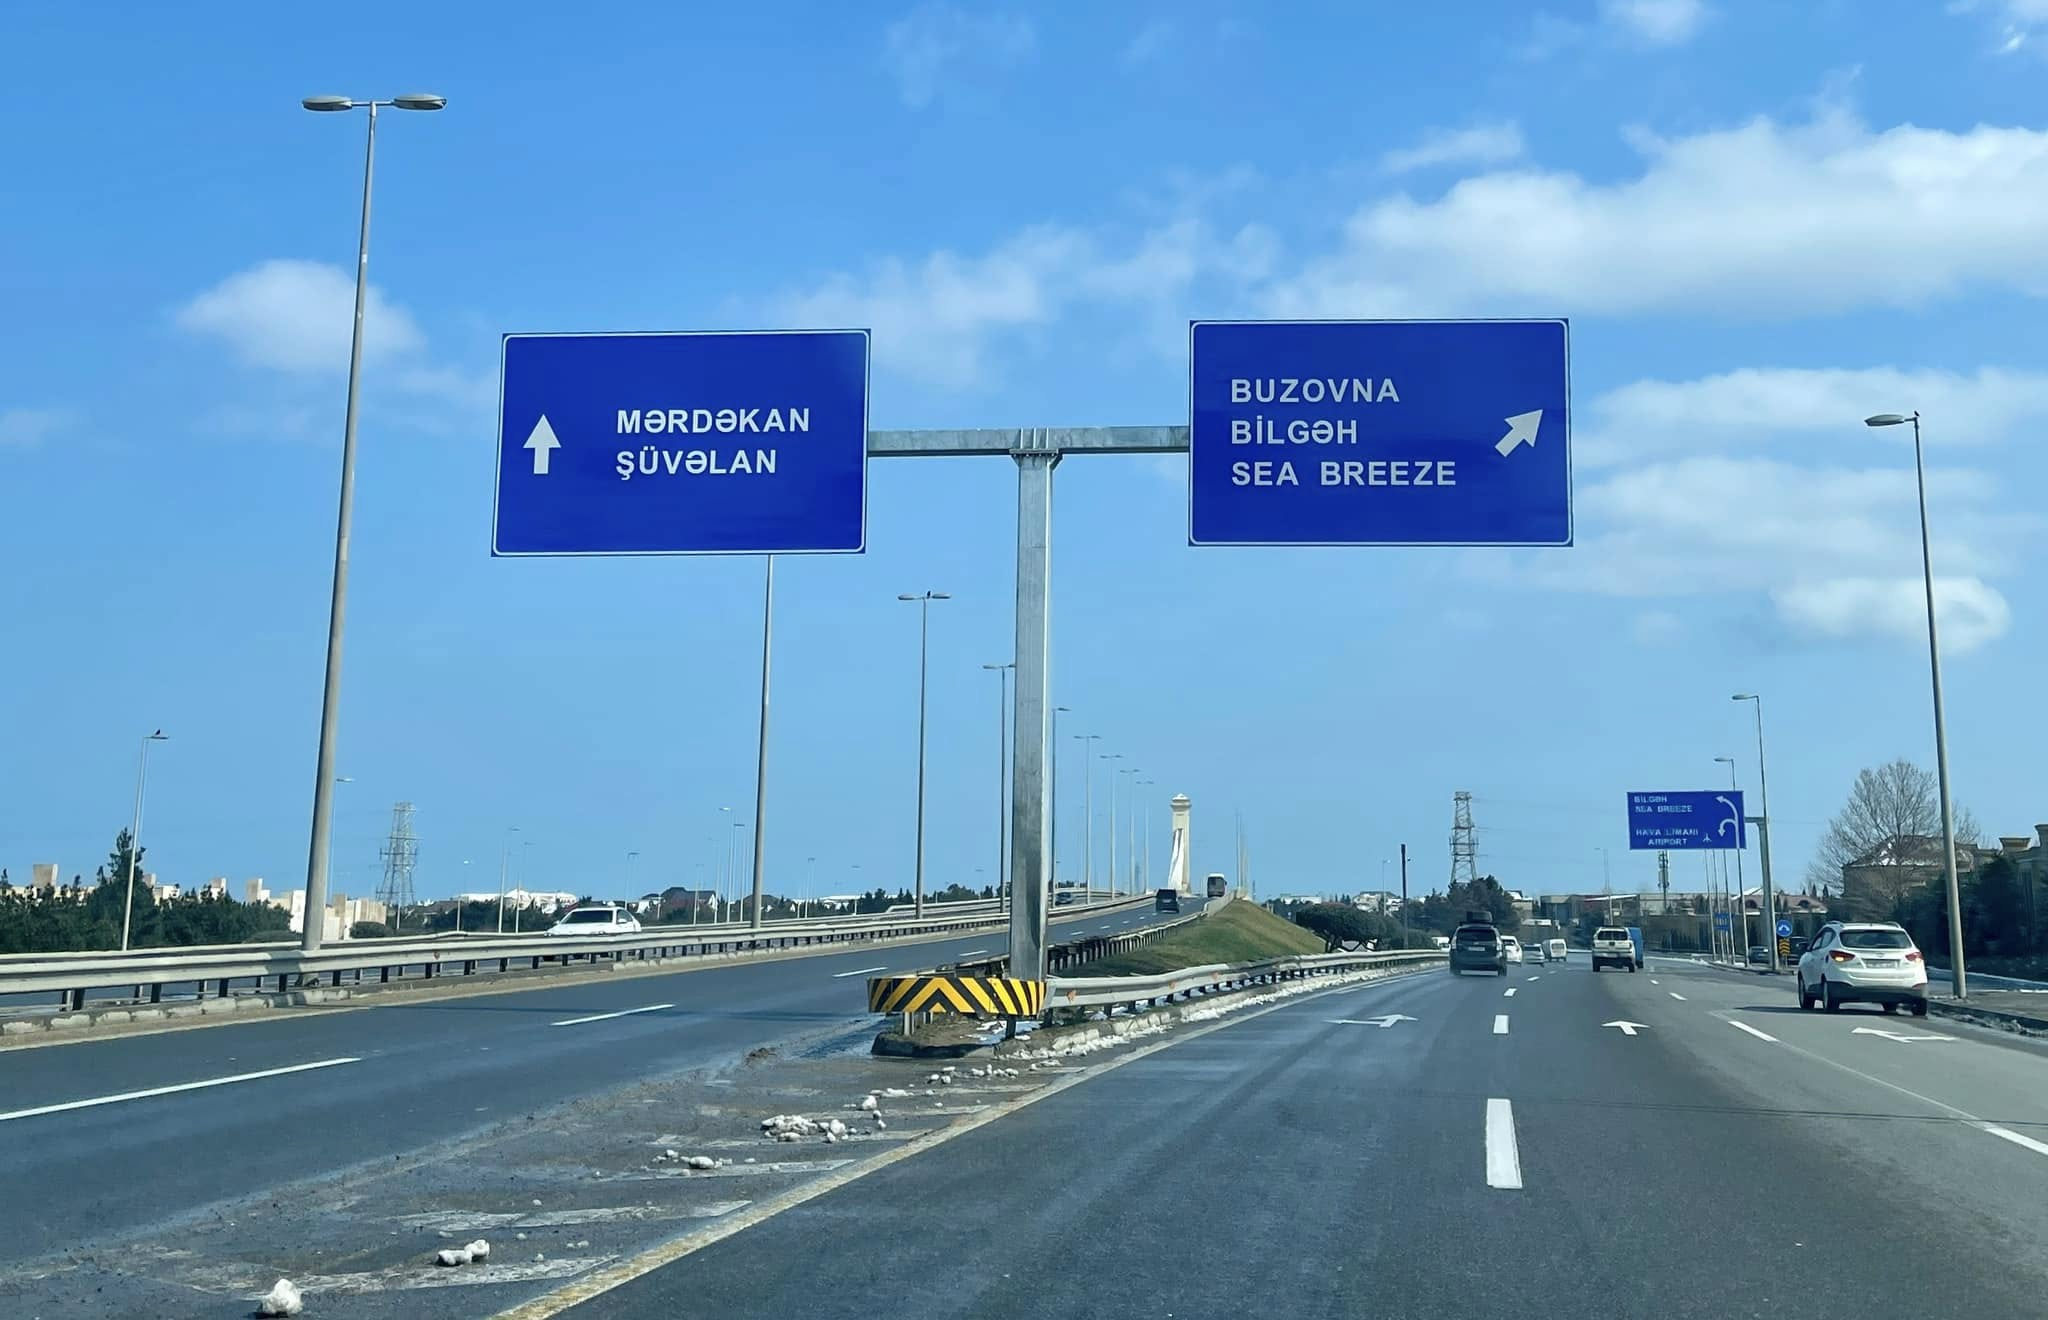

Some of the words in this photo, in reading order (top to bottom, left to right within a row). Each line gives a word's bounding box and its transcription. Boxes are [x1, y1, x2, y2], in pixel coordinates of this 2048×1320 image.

[1231, 378, 1400, 403] BUZOVNA
[616, 408, 810, 434] MƏRDƏKAN
[1231, 415, 1357, 444] BİLGƏH
[615, 445, 777, 481] ŞÜVƏLAN
[1231, 461, 1299, 486] SEA
[1321, 461, 1456, 486] BREEZE
[1647, 838, 1688, 846] AIRPORT
